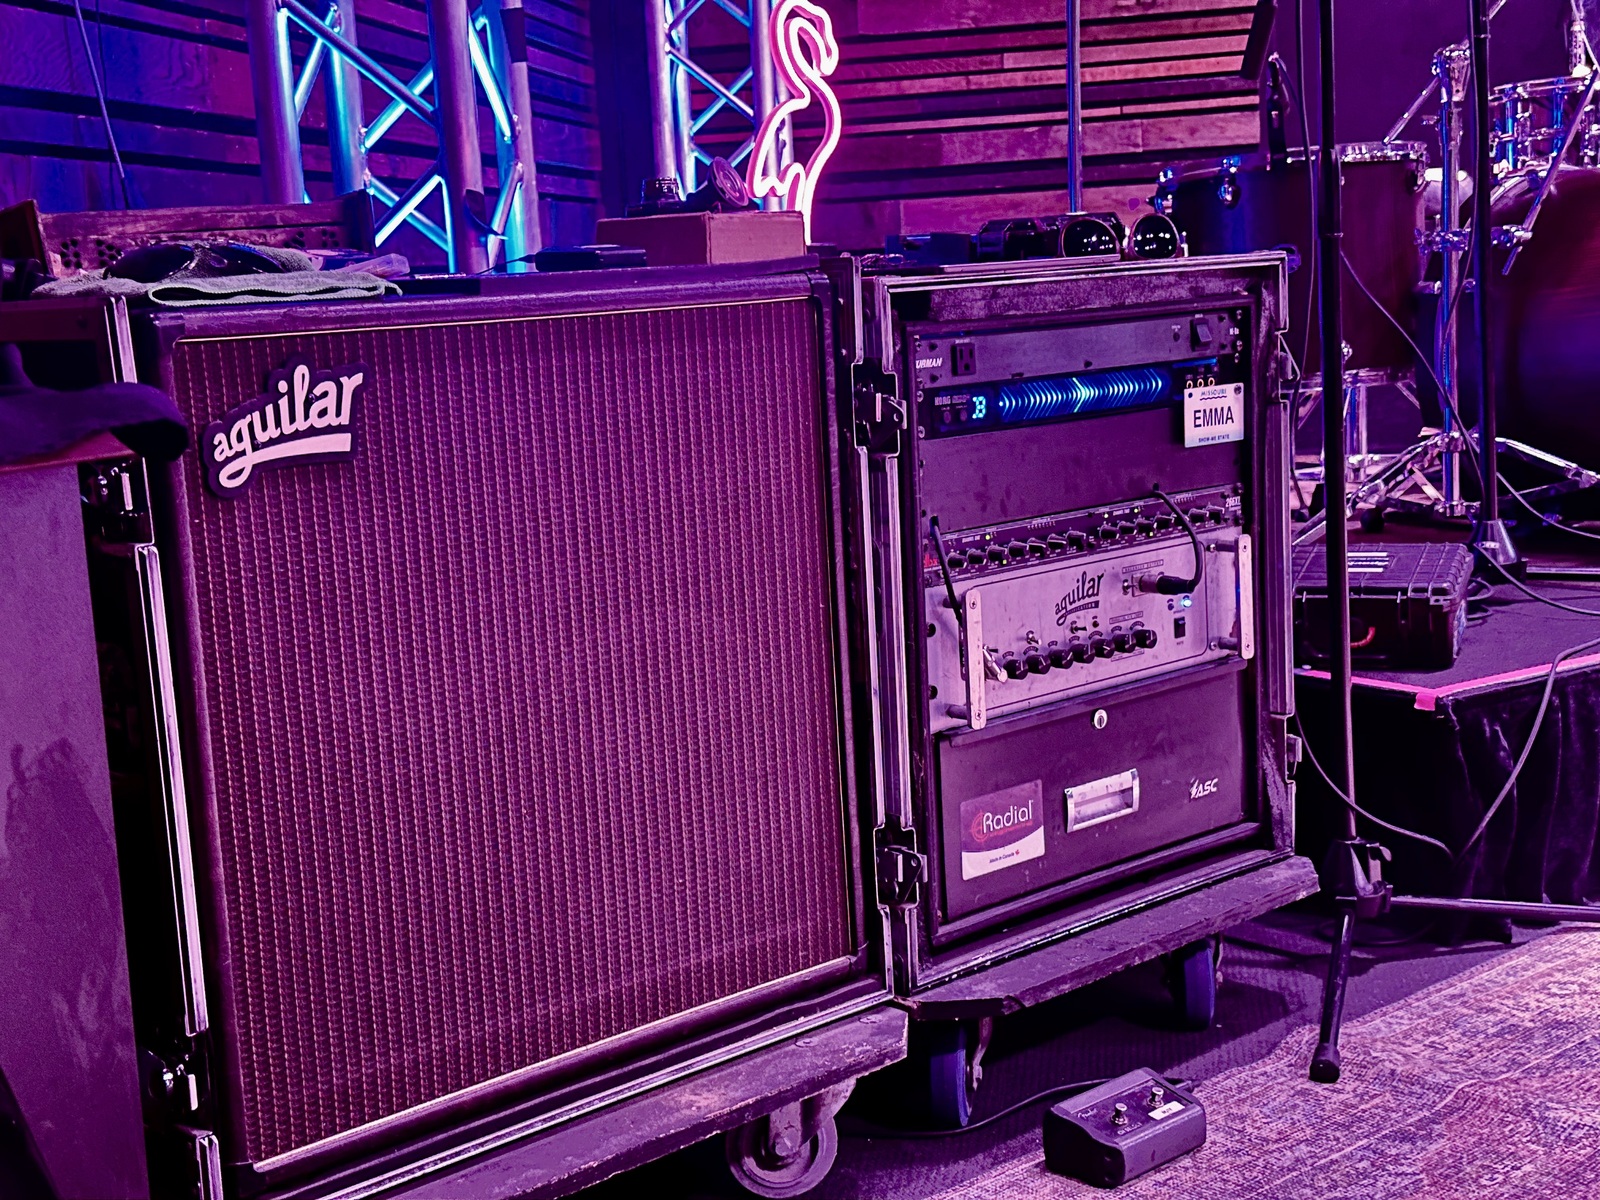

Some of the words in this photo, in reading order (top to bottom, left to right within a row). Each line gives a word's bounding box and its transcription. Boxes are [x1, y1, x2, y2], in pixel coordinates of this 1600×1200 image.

[1201, 388, 1226, 396] MISSOURI
[213, 364, 363, 488] aguilar
[1194, 406, 1234, 428] EMMA
[1217, 434, 1230, 442] STATE
[1055, 571, 1104, 626] aguilar
[983, 800, 1032, 834] Radial
